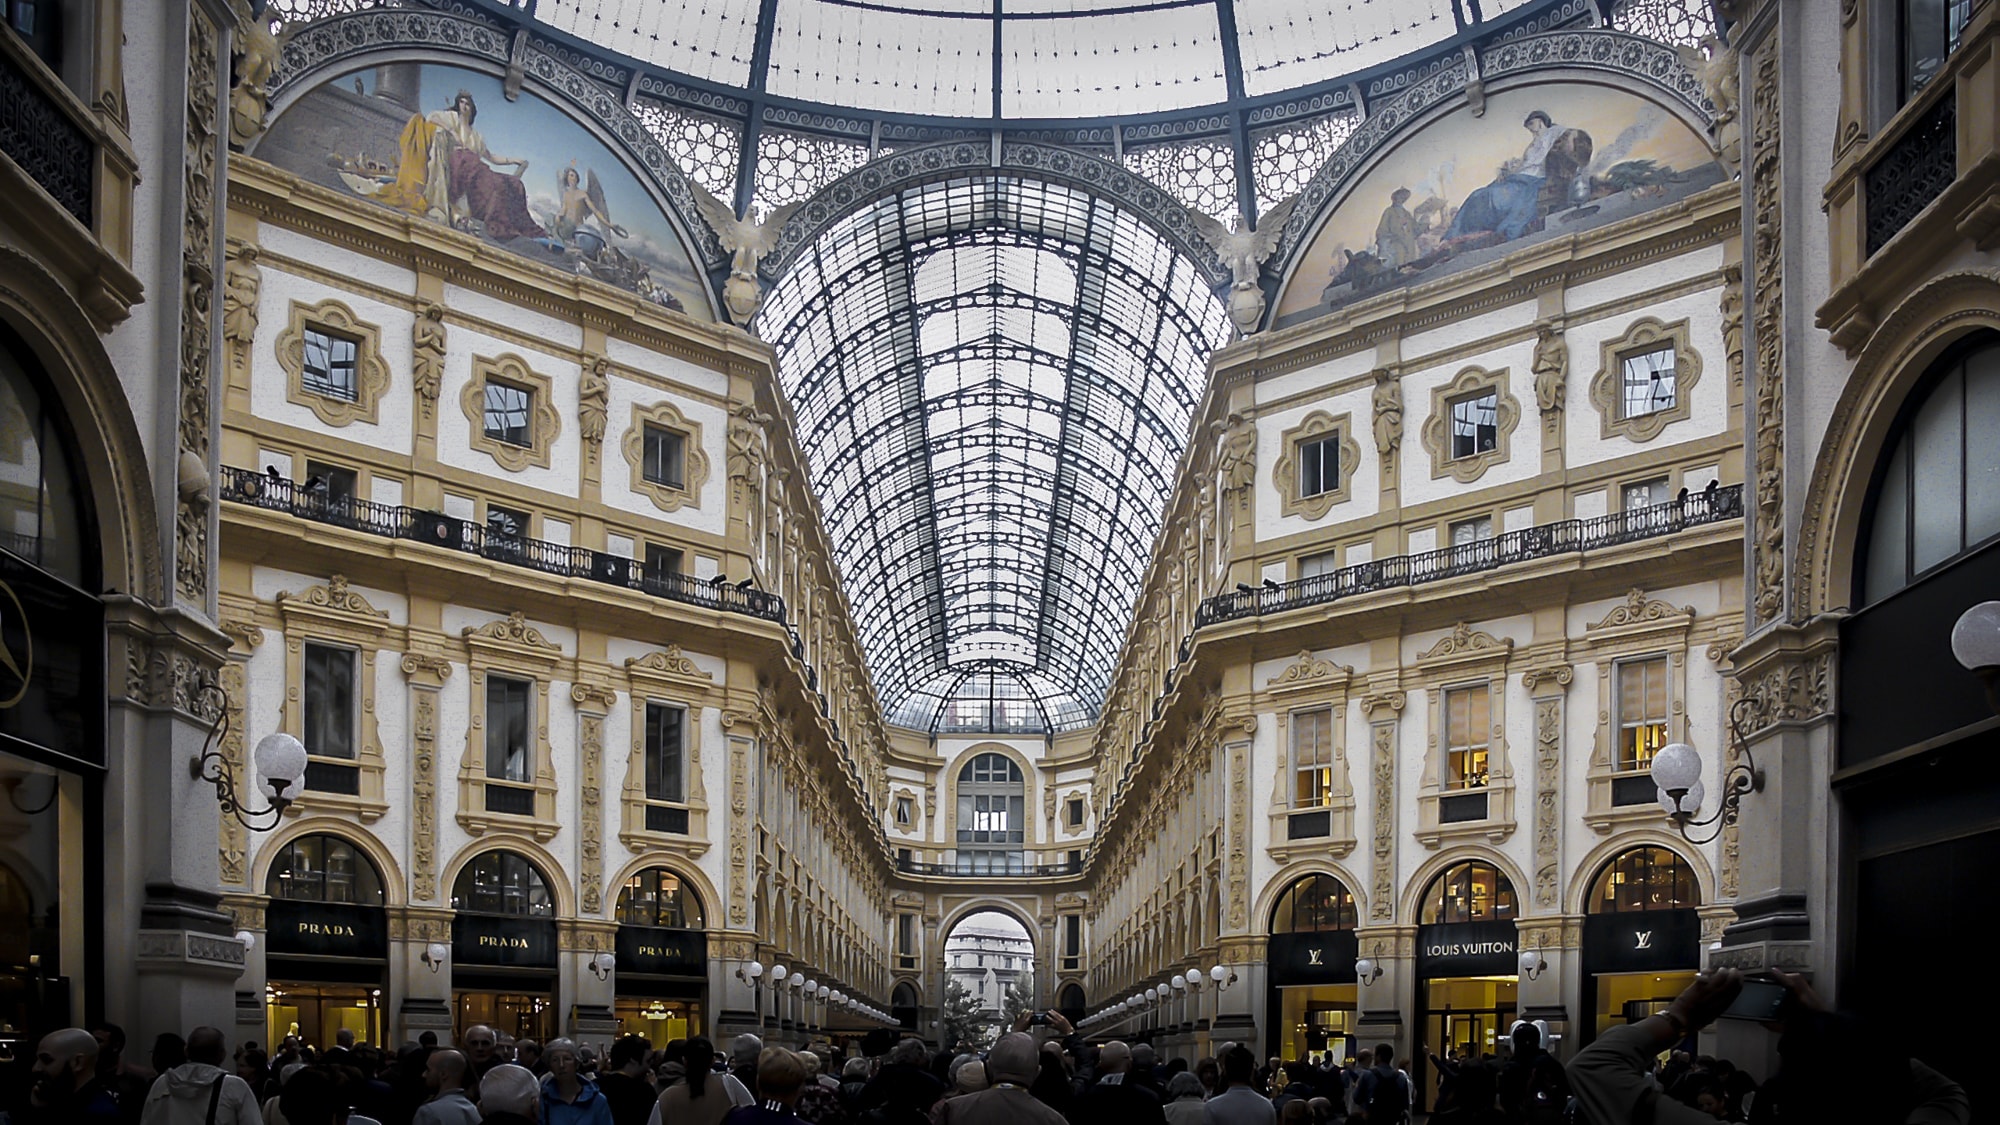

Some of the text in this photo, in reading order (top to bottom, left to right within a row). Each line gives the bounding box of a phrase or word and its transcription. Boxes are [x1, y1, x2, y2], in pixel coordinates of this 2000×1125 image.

[299, 922, 354, 936] PRADA
[479, 935, 528, 948] PRADA
[639, 946, 681, 957] PRADA
[1426, 941, 1513, 957] LOUIS VUITTON
